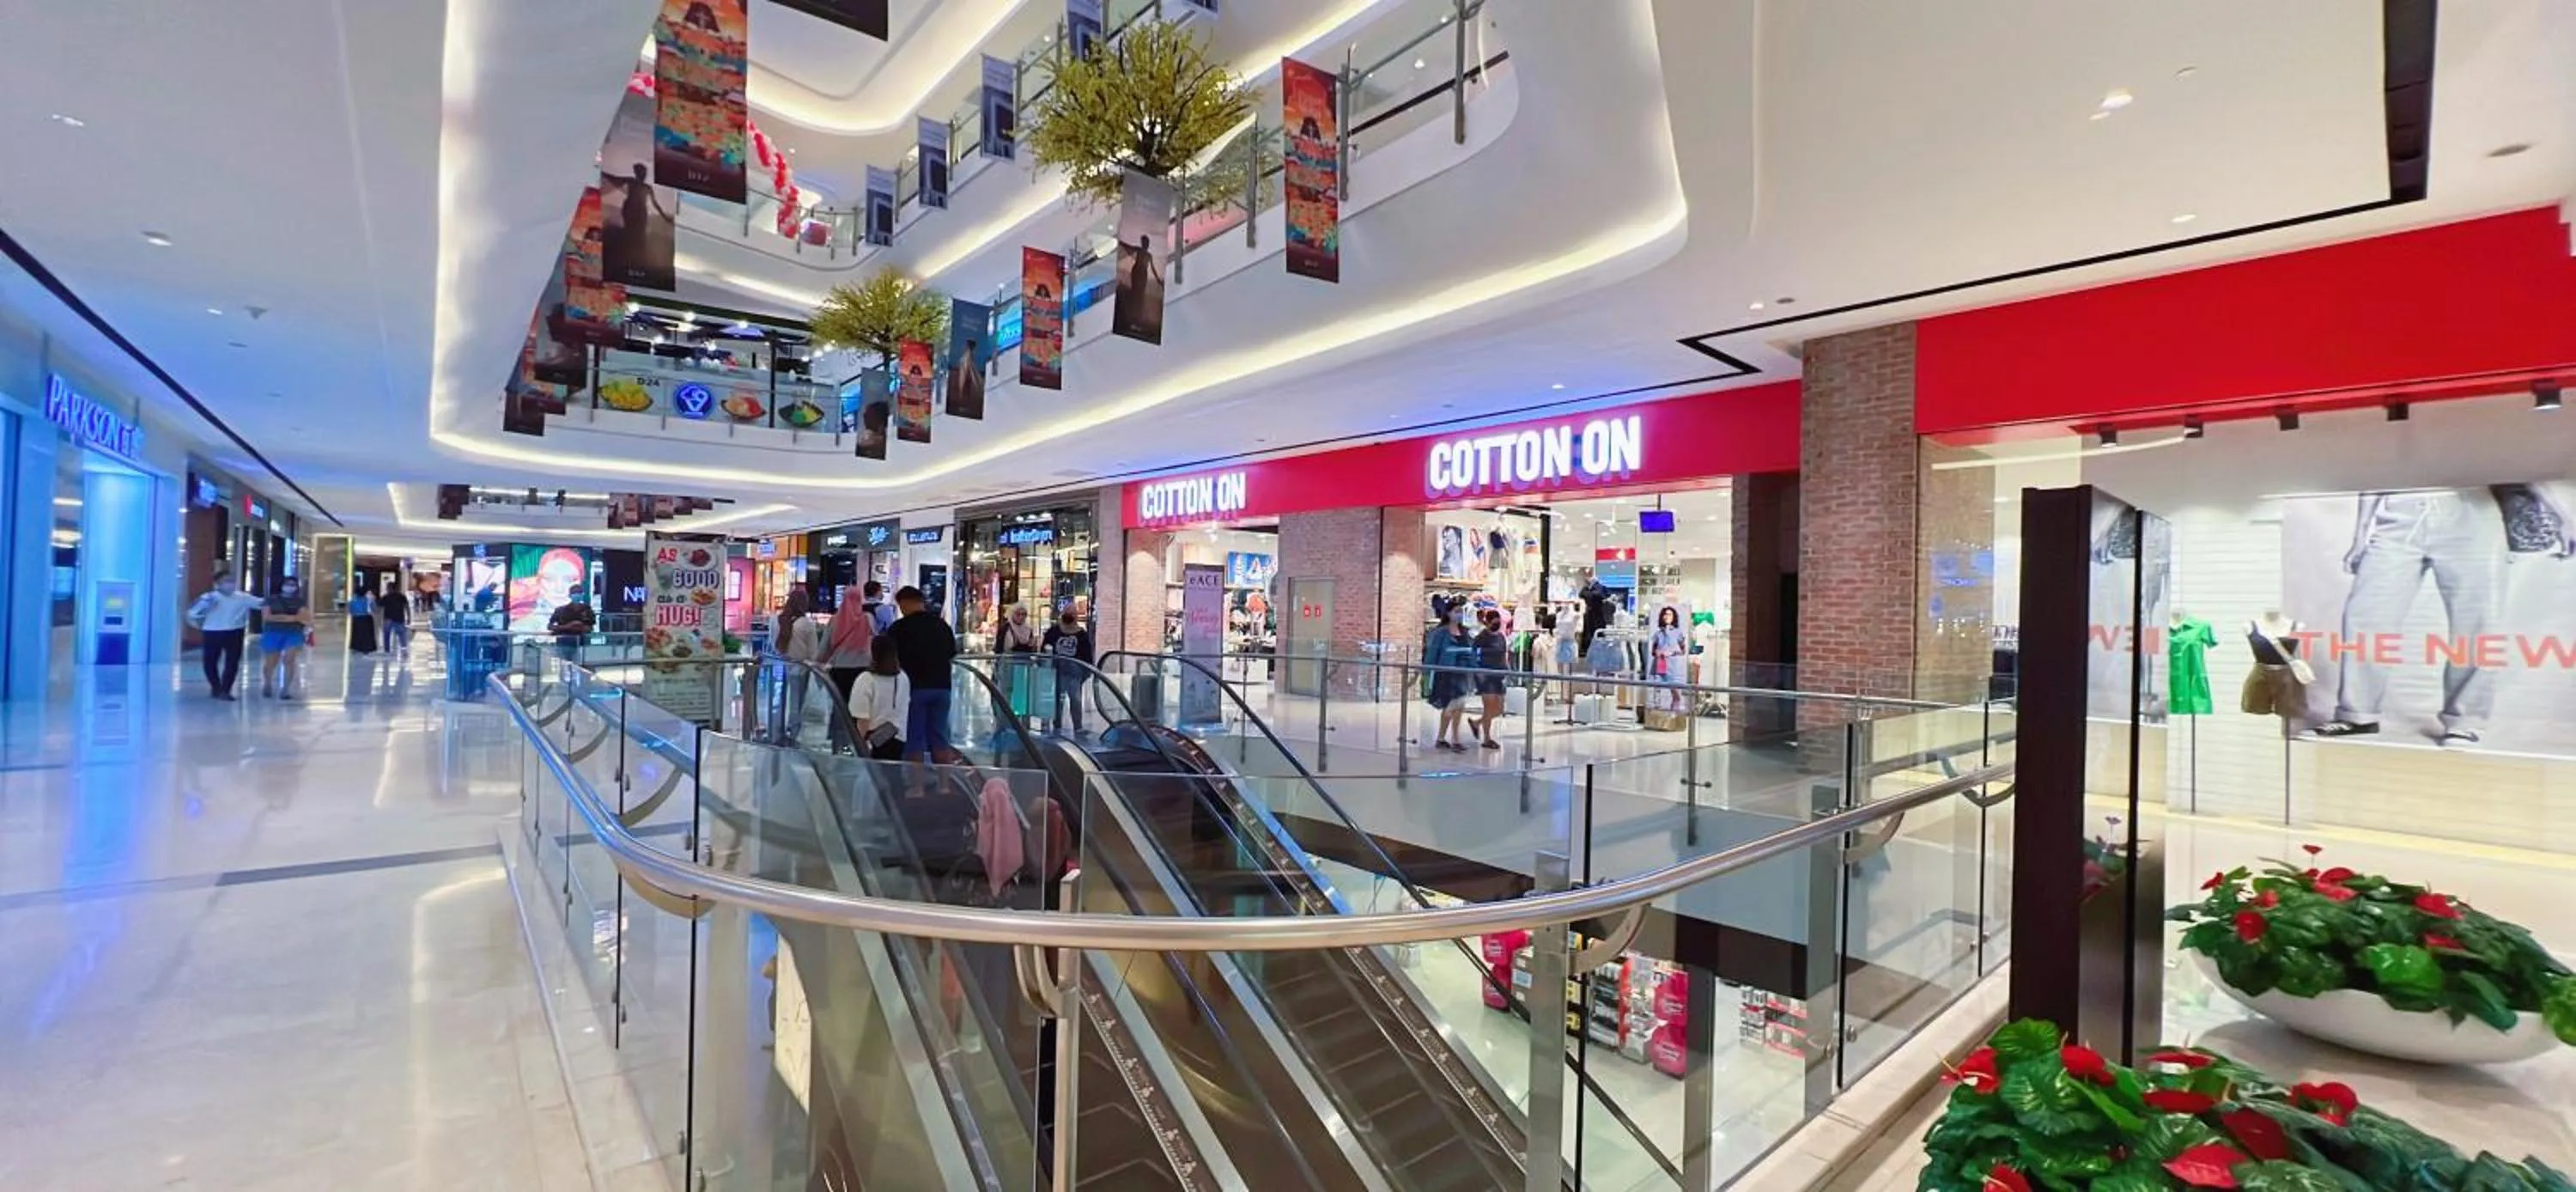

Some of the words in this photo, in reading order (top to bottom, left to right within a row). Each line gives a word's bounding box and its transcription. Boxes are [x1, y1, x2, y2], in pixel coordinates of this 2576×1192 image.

[47, 374, 121, 452] PARKSON
[1429, 425, 1571, 490] COTTON
[1581, 416, 1641, 474] ON
[1141, 477, 1213, 520] COTTON
[1217, 471, 1246, 511] ON
[657, 547, 677, 563] AS
[672, 568, 720, 589] GOOD
[1188, 575, 1219, 587] eACE
[656, 605, 702, 626] HUG!
[2289, 631, 2403, 665] THE
[2424, 633, 2576, 669] NEW
